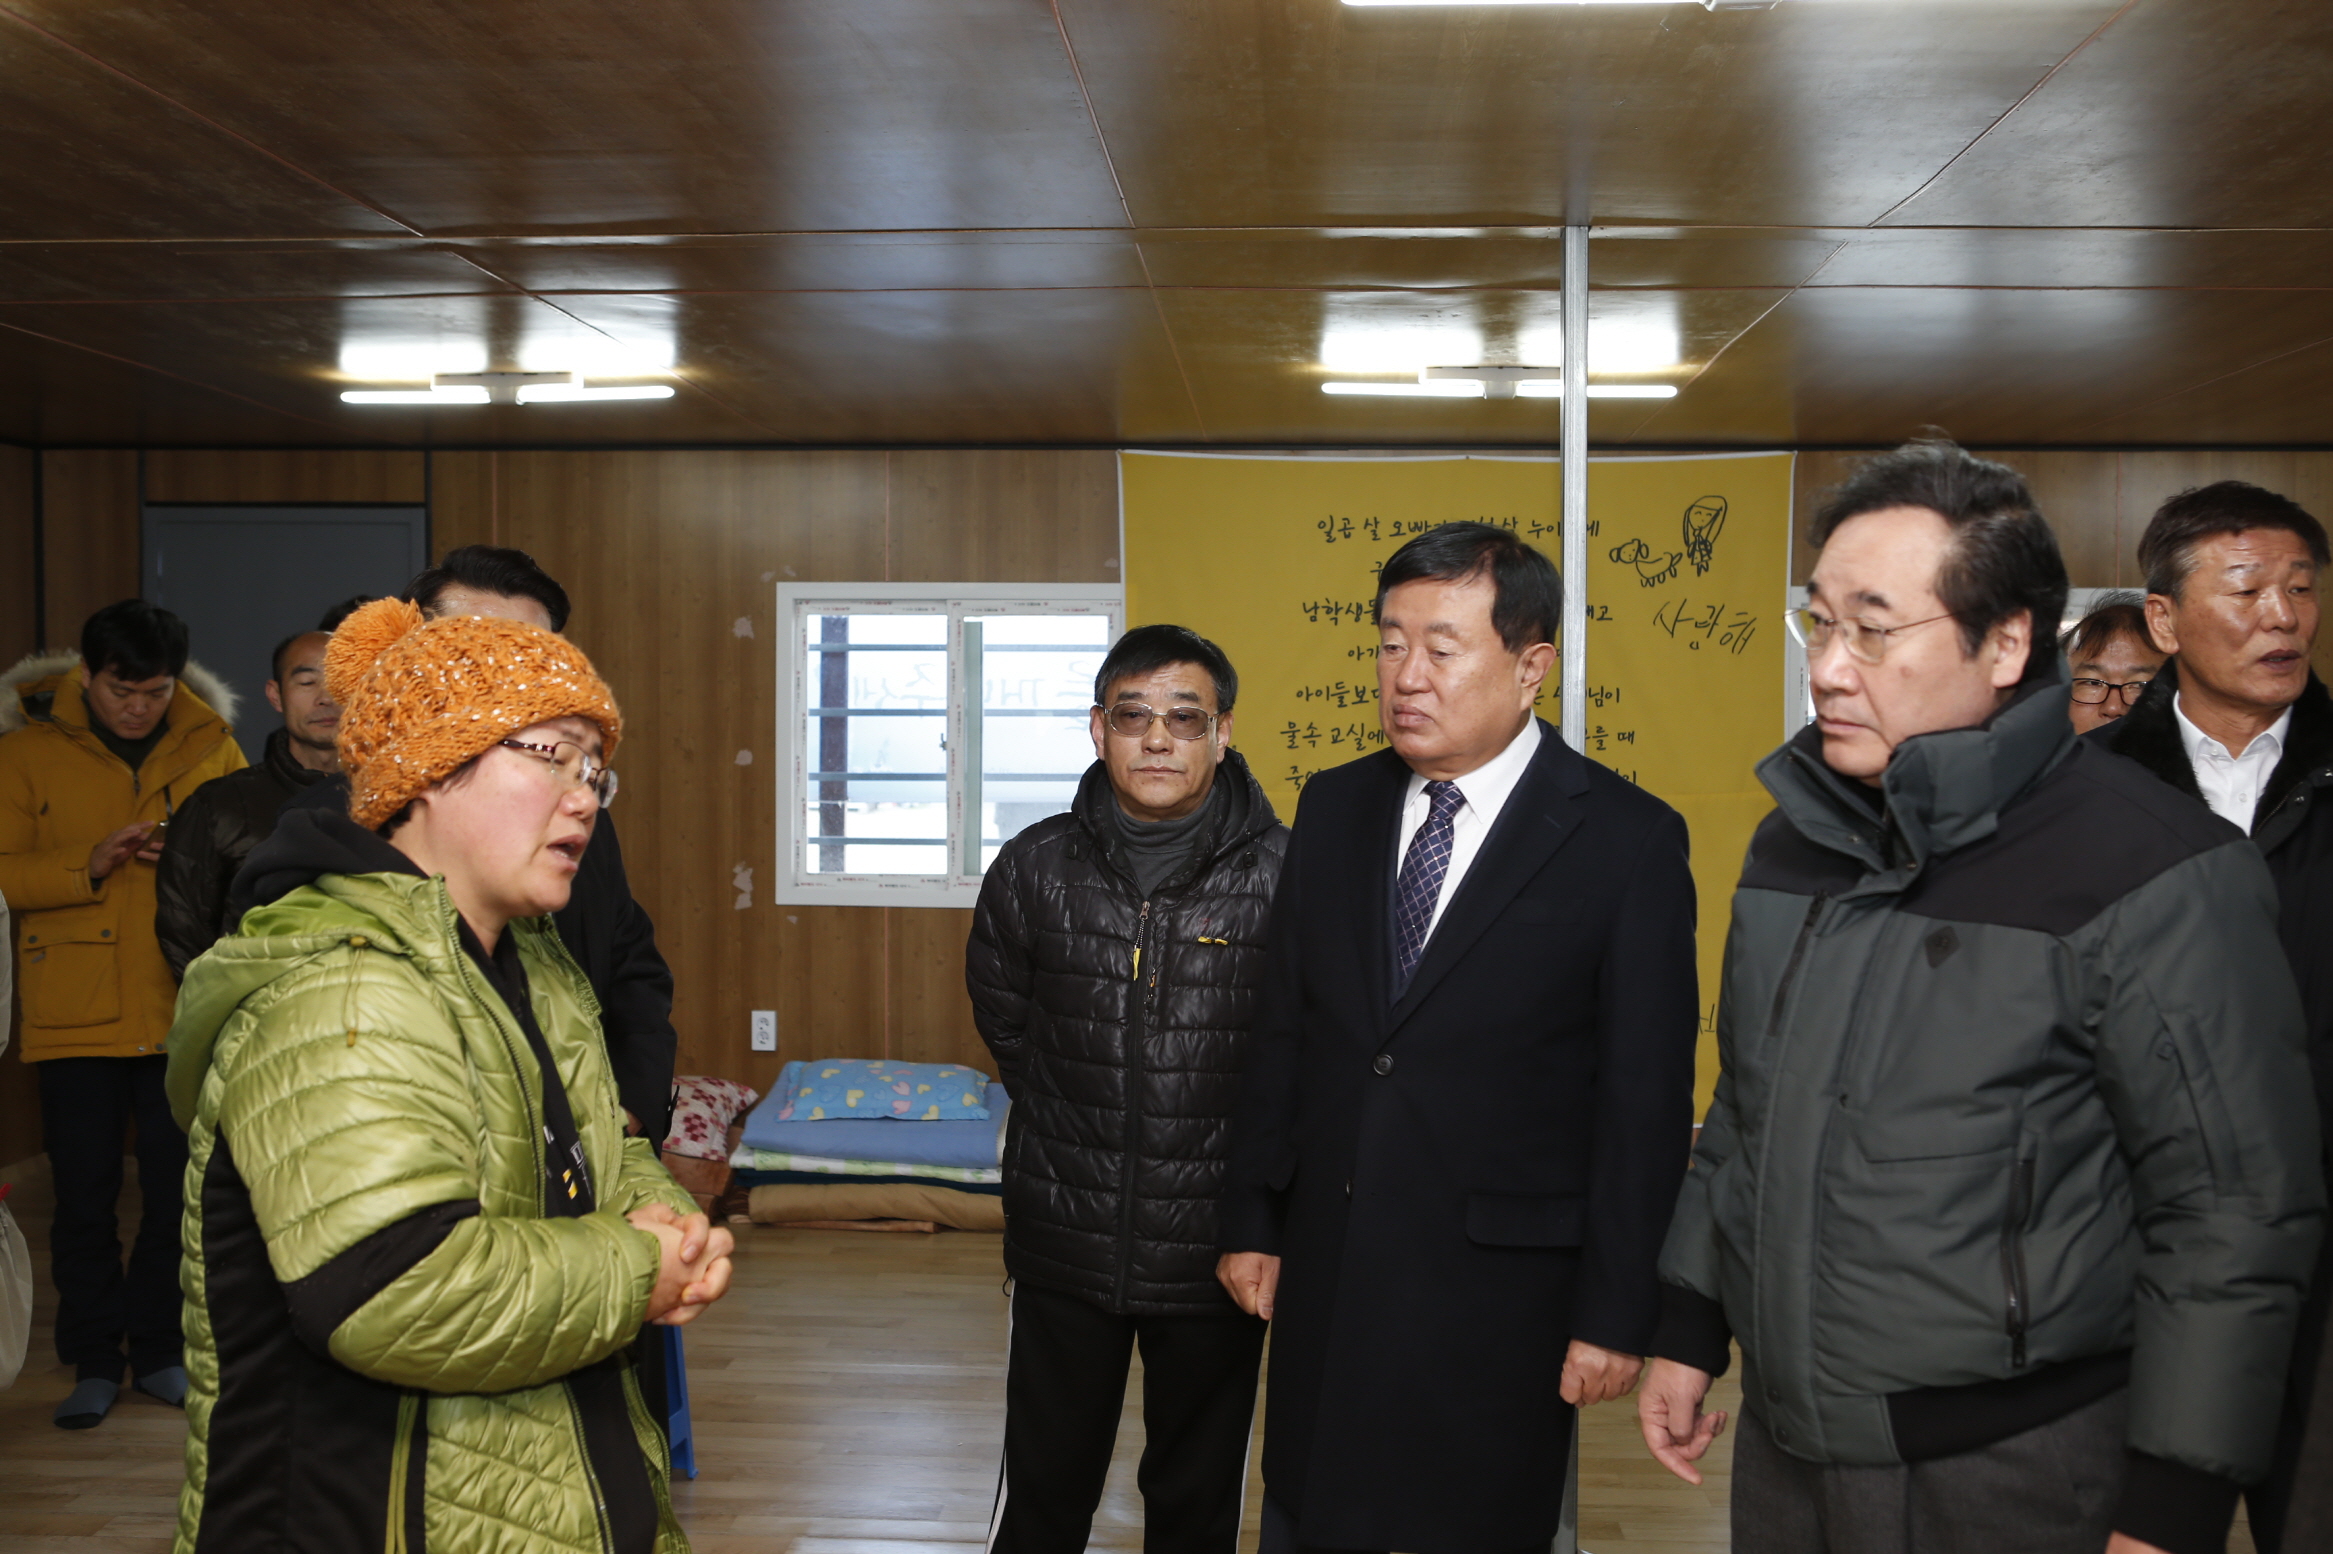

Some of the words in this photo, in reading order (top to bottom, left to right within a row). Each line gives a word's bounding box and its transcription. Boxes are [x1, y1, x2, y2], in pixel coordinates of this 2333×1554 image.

[1317, 514, 1355, 543] 일곱
[1363, 516, 1381, 541] 살
[1652, 598, 1757, 655] 사랑해
[1280, 721, 1322, 749] 물속
[1330, 722, 1384, 751] 교실에
[1617, 730, 1635, 745] 때
